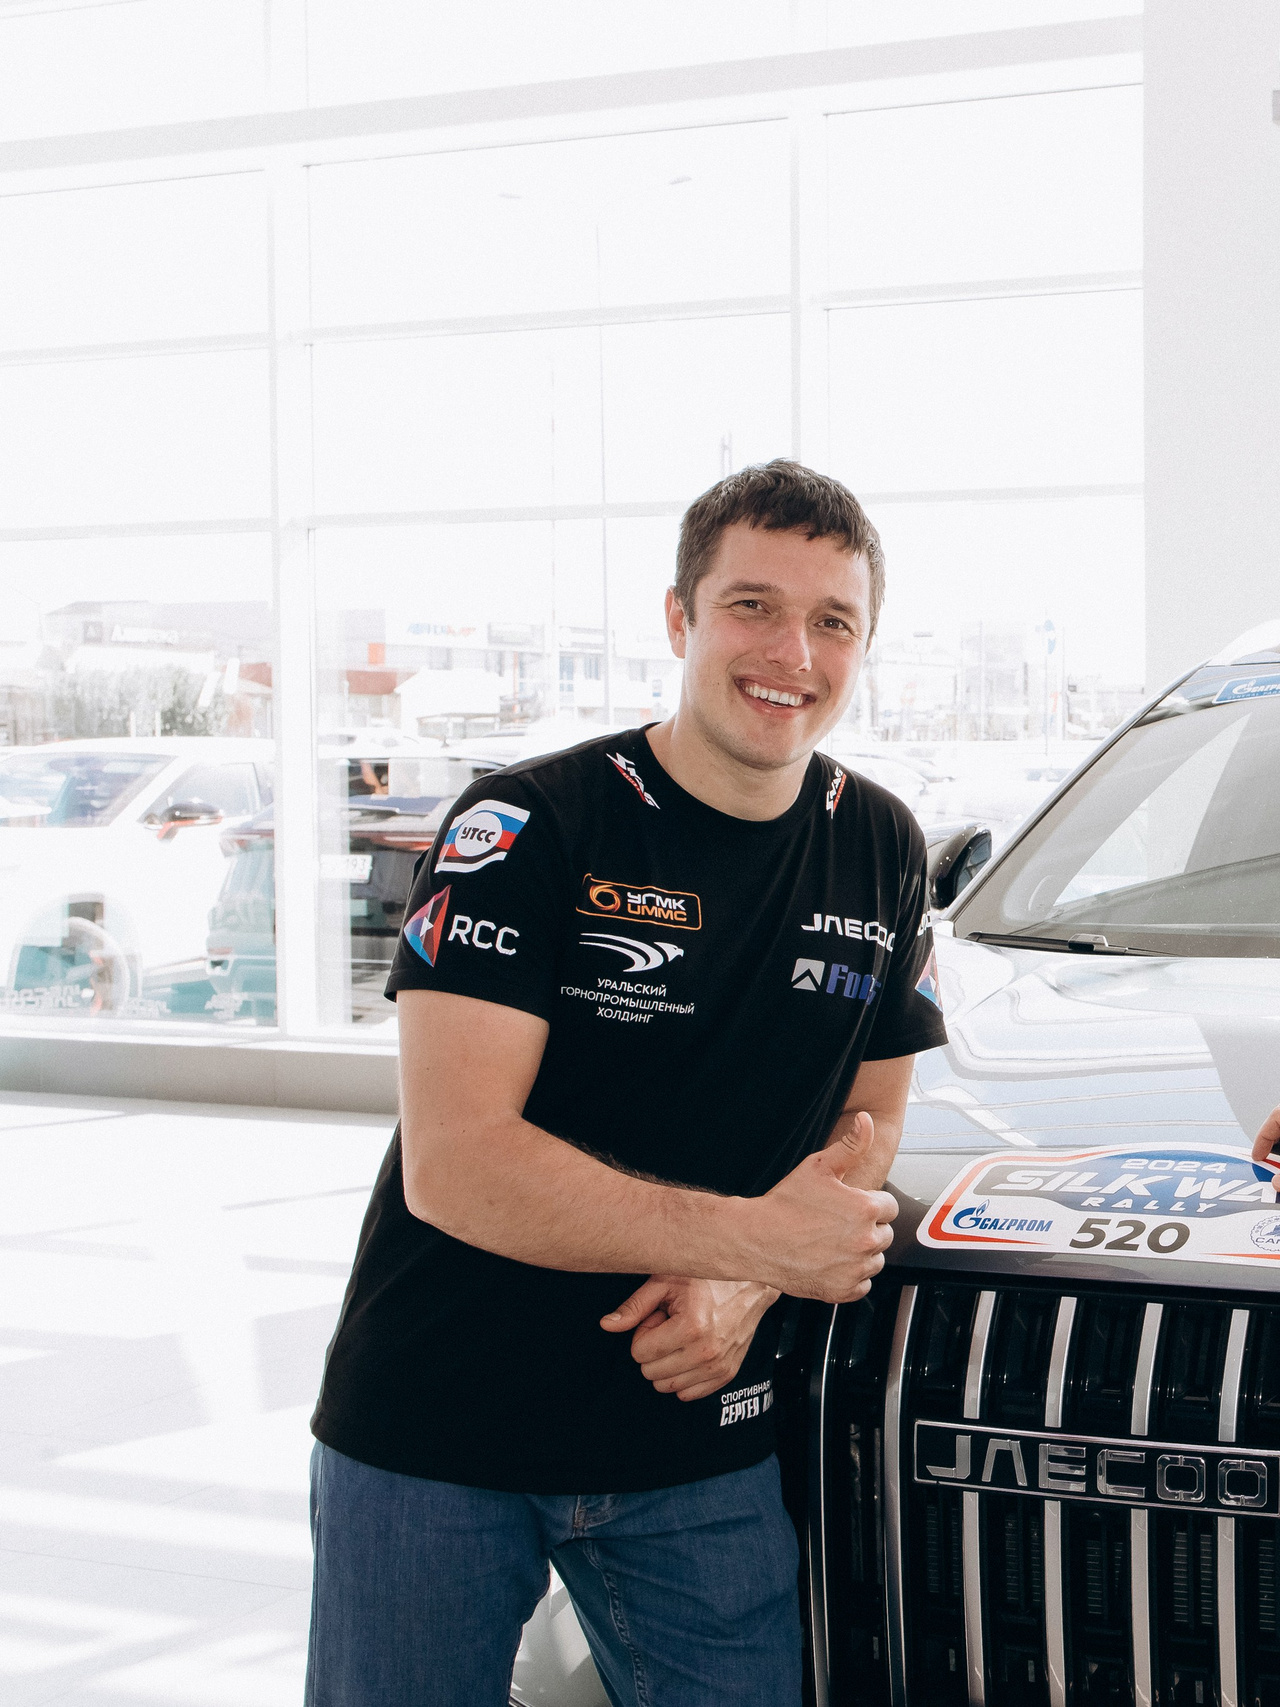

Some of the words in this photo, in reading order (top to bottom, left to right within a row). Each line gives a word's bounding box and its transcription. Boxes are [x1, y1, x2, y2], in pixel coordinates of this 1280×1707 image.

[460, 826, 497, 844] УТСС
[626, 891, 687, 911] УГМК
[626, 903, 688, 922] UMMC
[447, 914, 521, 956] RCC
[597, 977, 667, 998] УРАЛЬСКИЙ
[560, 985, 696, 1015] ГОРНОПРОМЫШЛЕННЫЙ
[596, 1006, 654, 1023] ХОЛДИНГ
[1120, 1158, 1227, 1174] 2024
[990, 1170, 1174, 1197] SILK
[1081, 1196, 1218, 1213] RALLY
[979, 1217, 1054, 1232] GAZPROM
[1069, 1218, 1191, 1254] 520
[719, 1395, 760, 1427] СЕРГЕЯ
[926, 1434, 1268, 1508] JAECOO
